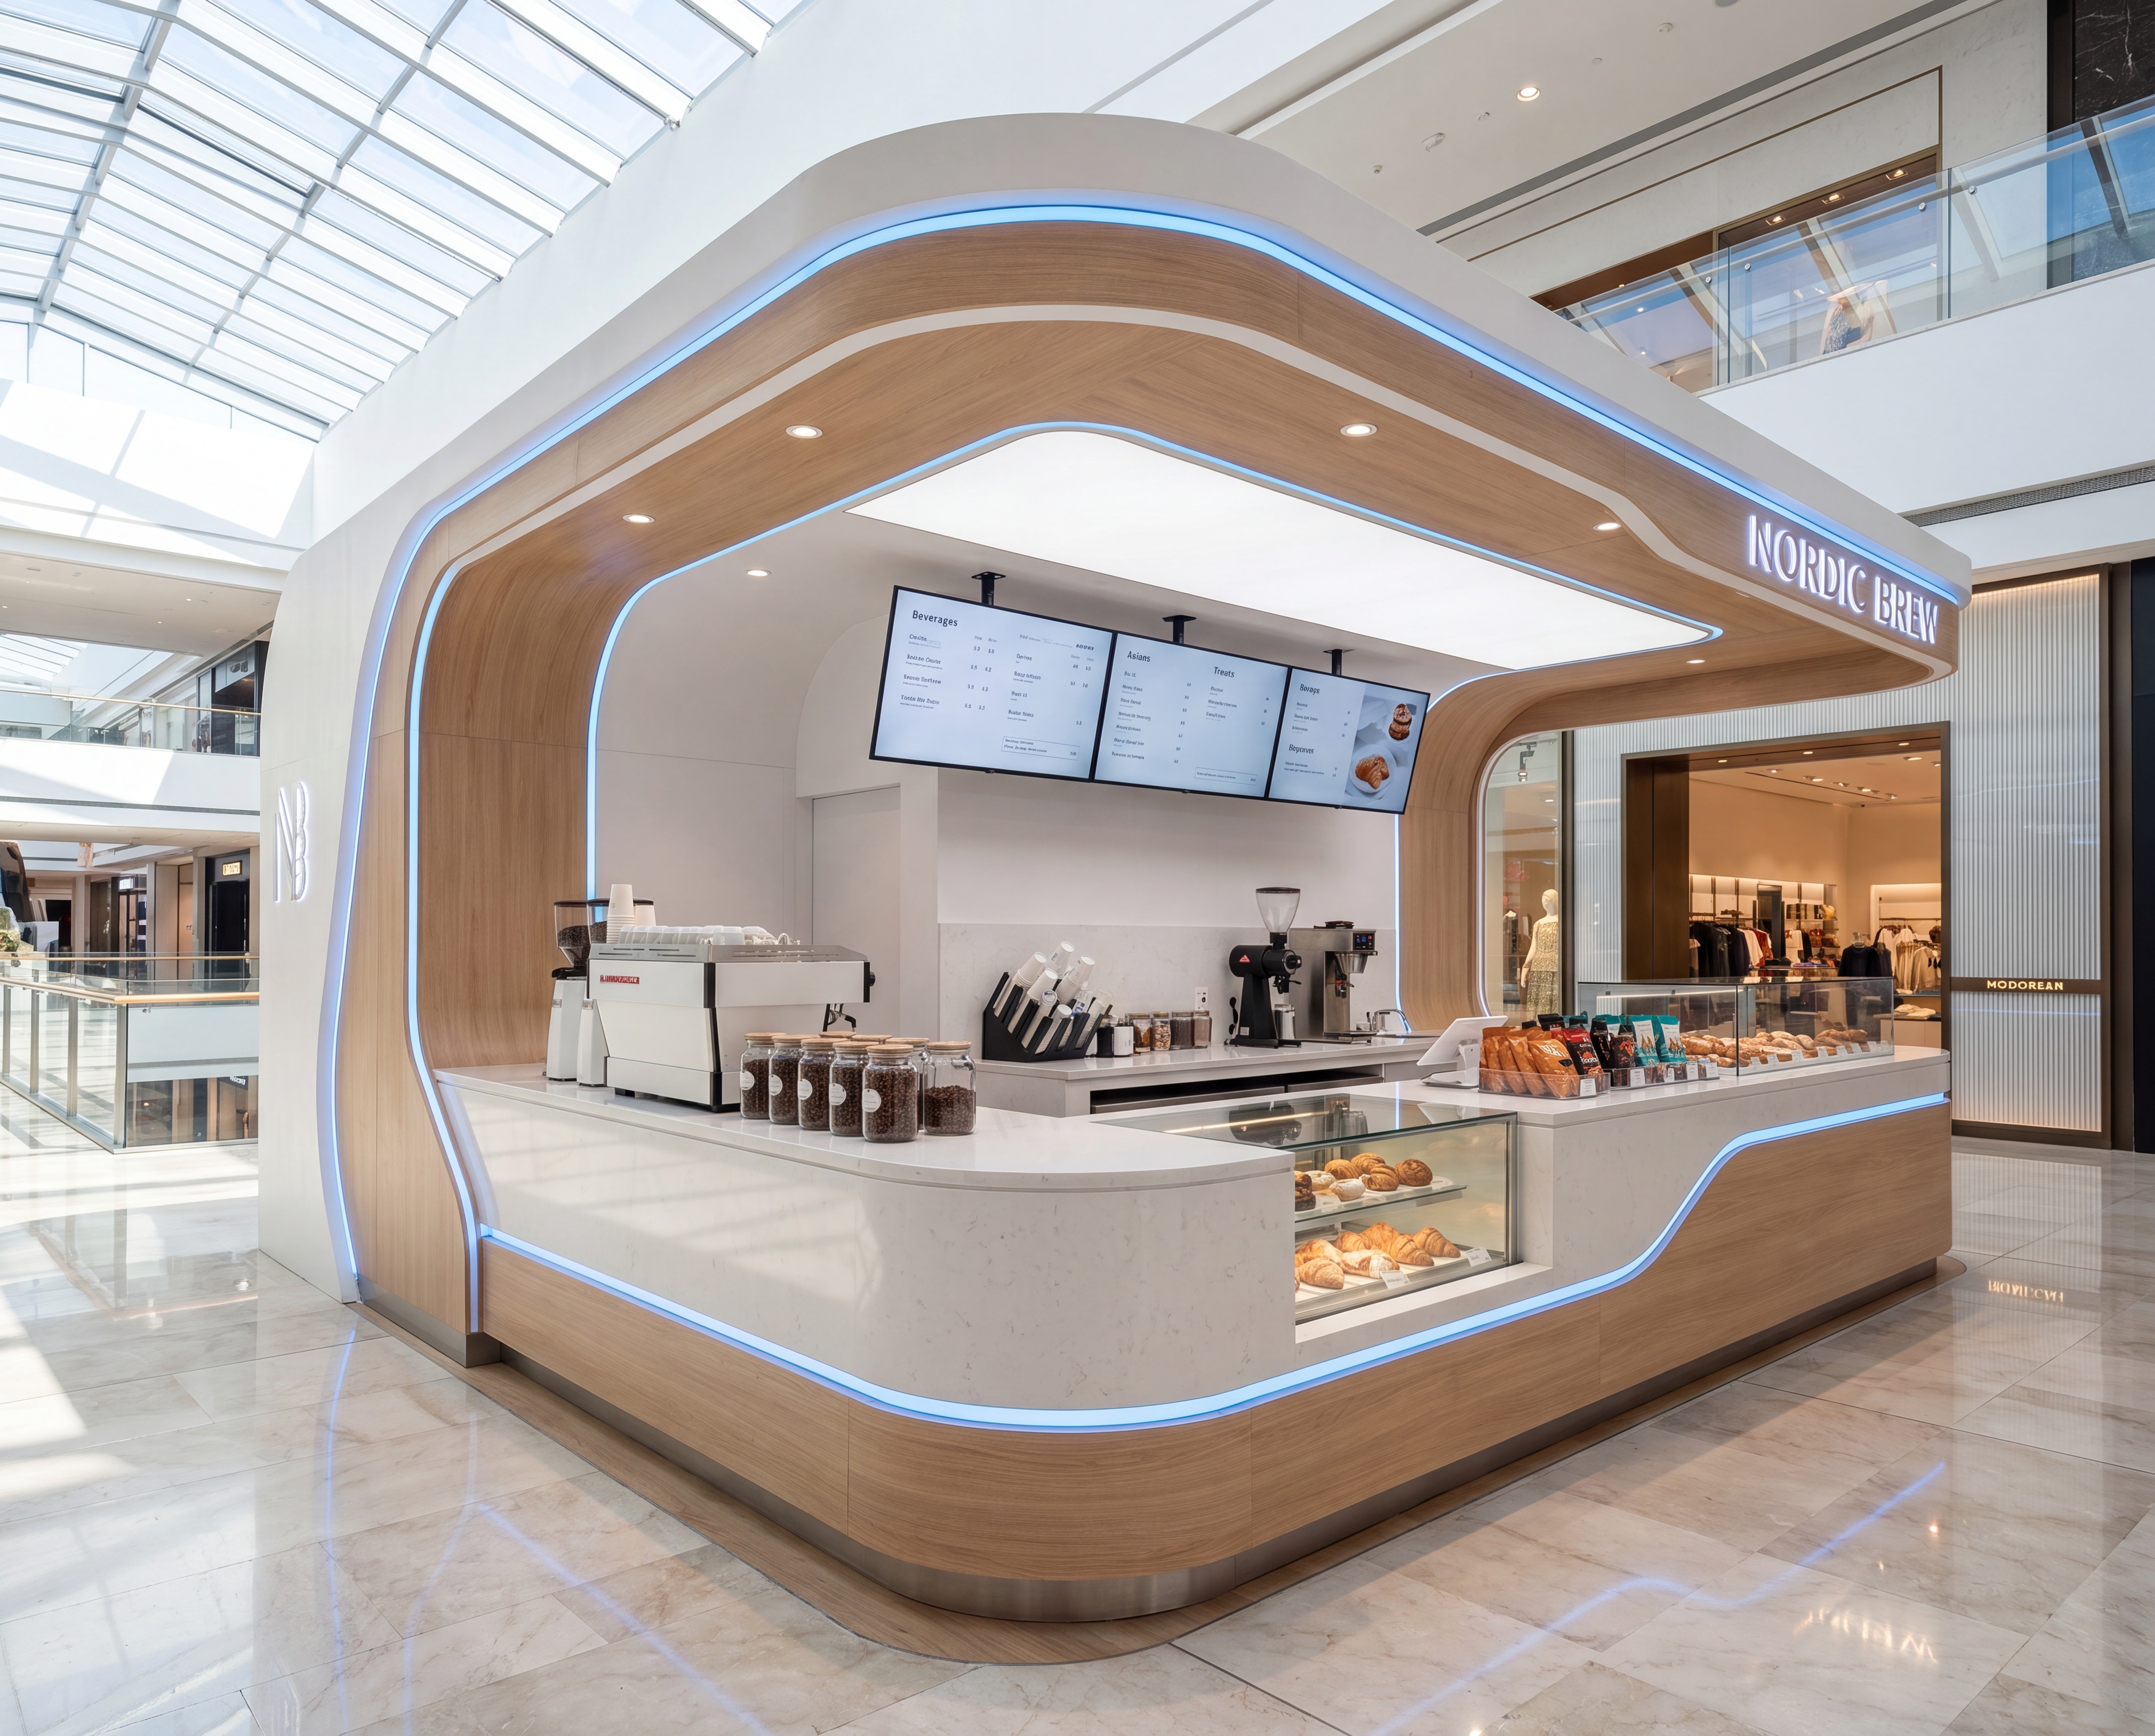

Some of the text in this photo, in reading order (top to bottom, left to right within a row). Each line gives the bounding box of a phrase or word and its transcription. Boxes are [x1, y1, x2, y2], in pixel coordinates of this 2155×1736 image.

[1749, 515, 1938, 644] NORDIC BREW
[912, 610, 958, 627] Beverages
[1127, 651, 1151, 662] Asians
[1214, 666, 1235, 678] Treats
[1987, 980, 2063, 990] MODOREAN
